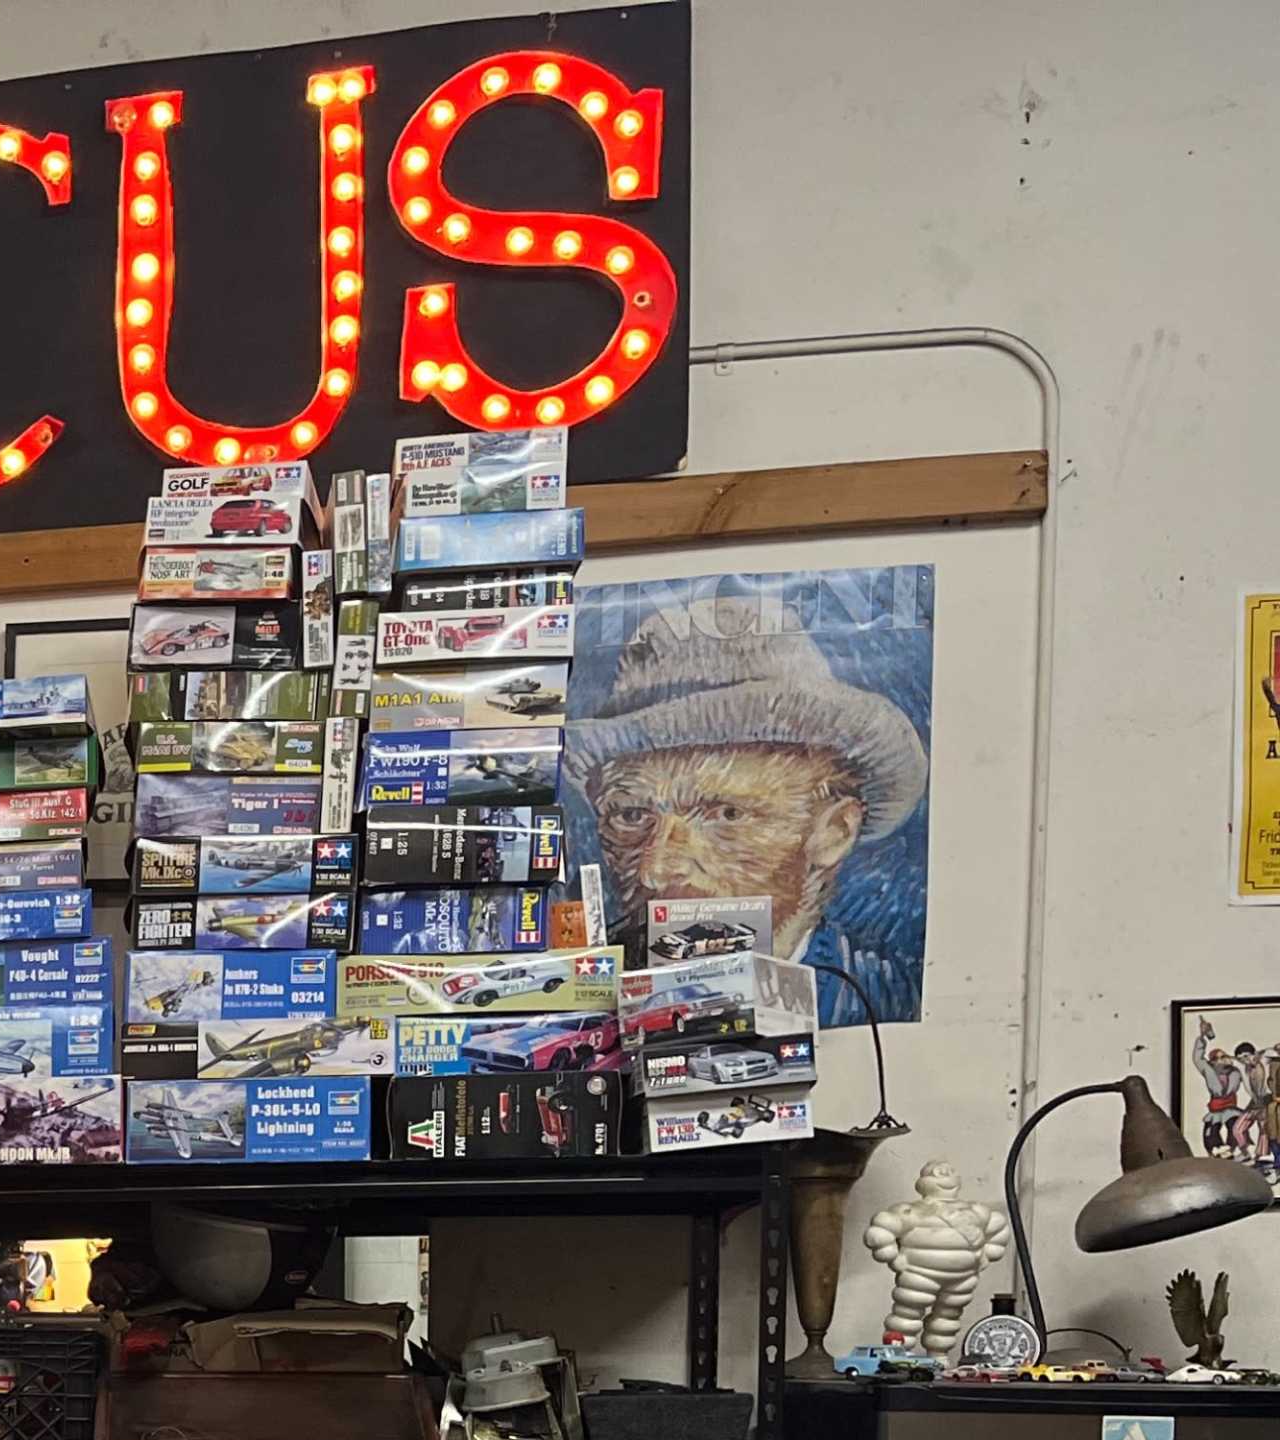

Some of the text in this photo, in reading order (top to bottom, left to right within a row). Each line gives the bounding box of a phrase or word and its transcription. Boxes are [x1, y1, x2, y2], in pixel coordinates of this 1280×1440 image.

[425, 446, 466, 459] MUSTANG
[168, 478, 210, 493] GOLF
[150, 499, 185, 509] LANCIA
[149, 560, 195, 571] THUNDERBOLT
[383, 620, 434, 635] TOYOTA
[383, 632, 431, 648] GT-One
[375, 692, 464, 708] M1A1 AIM
[371, 784, 410, 802] Revell
[231, 798, 268, 810] Tiger
[397, 832, 409, 856] 1:25
[453, 808, 468, 881] Meredes-Benz
[539, 818, 558, 856] Rvell
[141, 851, 197, 867] SPITFIRE
[55, 895, 81, 906] 1:32
[139, 909, 172, 925] ZERO
[521, 892, 540, 931] Revell
[138, 923, 192, 939] FIGHTER
[20, 949, 60, 965] Vought
[290, 990, 325, 1004] 03214
[70, 1014, 98, 1027] 1:24
[399, 1023, 467, 1046] PETTY
[399, 1054, 459, 1063] CHARGER
[646, 1055, 686, 1069] NISMO
[257, 1085, 315, 1100] Lockheed
[255, 1121, 315, 1137] Lightning
[433, 1111, 445, 1157] ITALERI
[454, 1130, 466, 1157] FIAT
[657, 1133, 702, 1146] RENAULT
